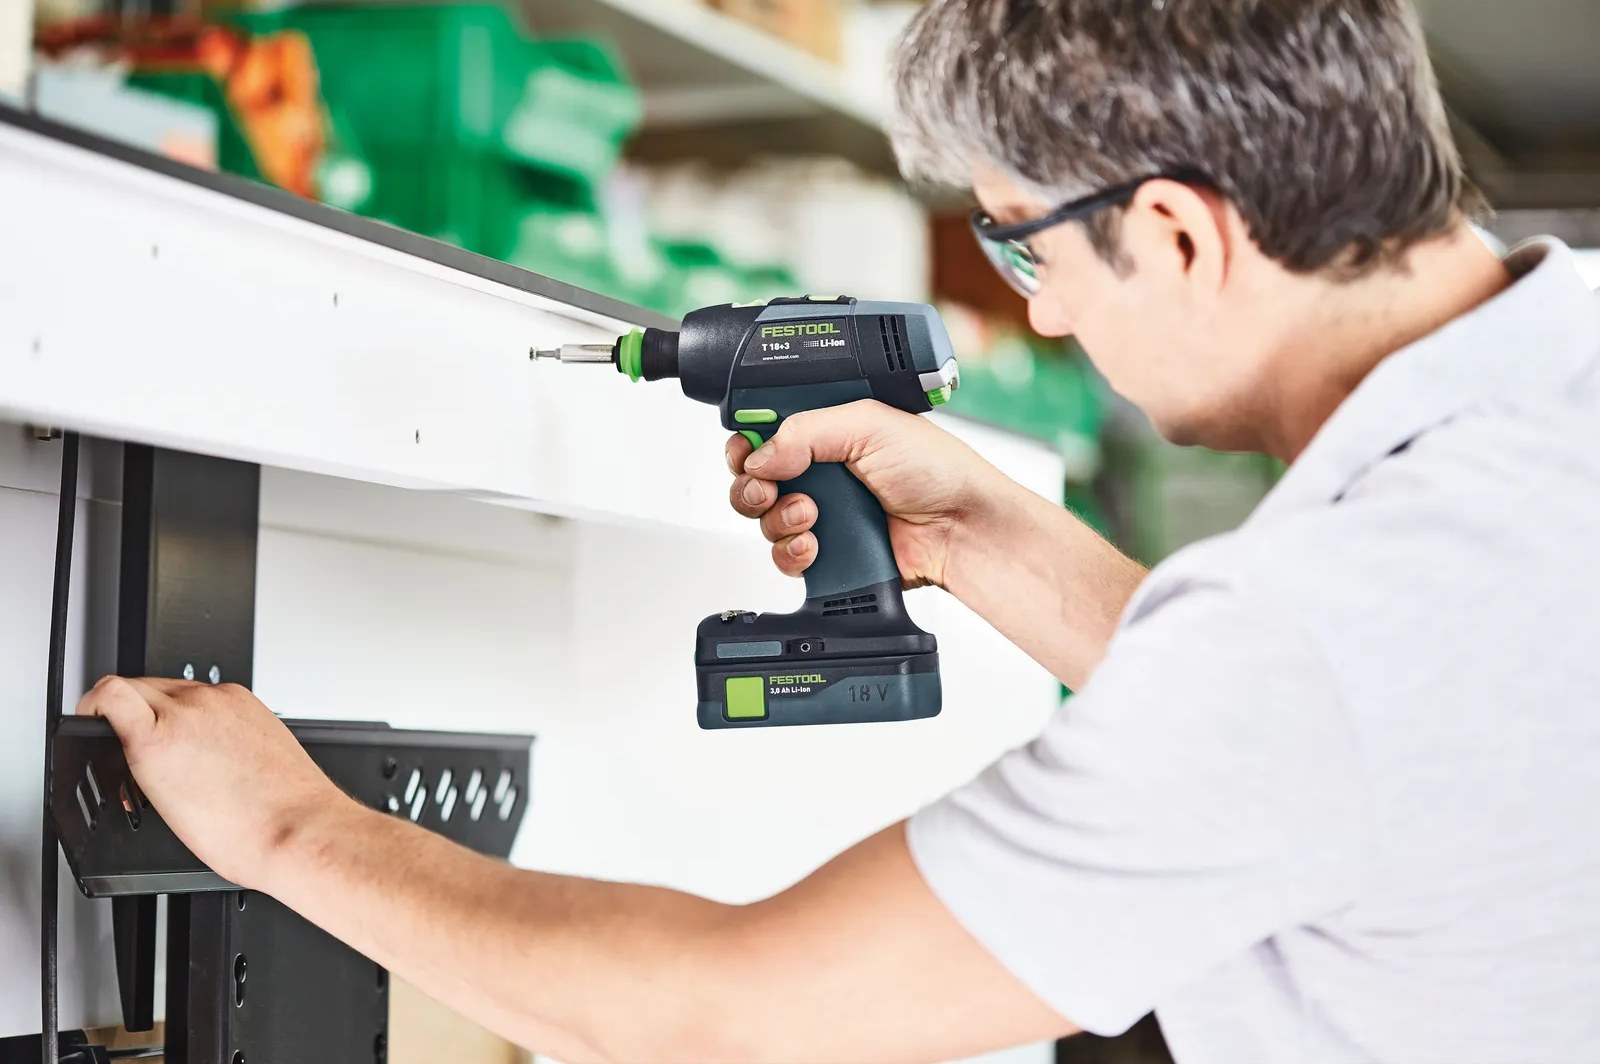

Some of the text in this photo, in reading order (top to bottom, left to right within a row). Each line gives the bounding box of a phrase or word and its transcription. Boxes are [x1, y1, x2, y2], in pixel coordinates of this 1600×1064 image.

[761, 323, 840, 338] FESTOOL
[762, 342, 790, 351] T 18+3
[820, 339, 845, 348] Li-Ion
[769, 674, 827, 685] FESTOOL
[791, 685, 811, 693] Li-Ion
[848, 683, 889, 702] 18 V
